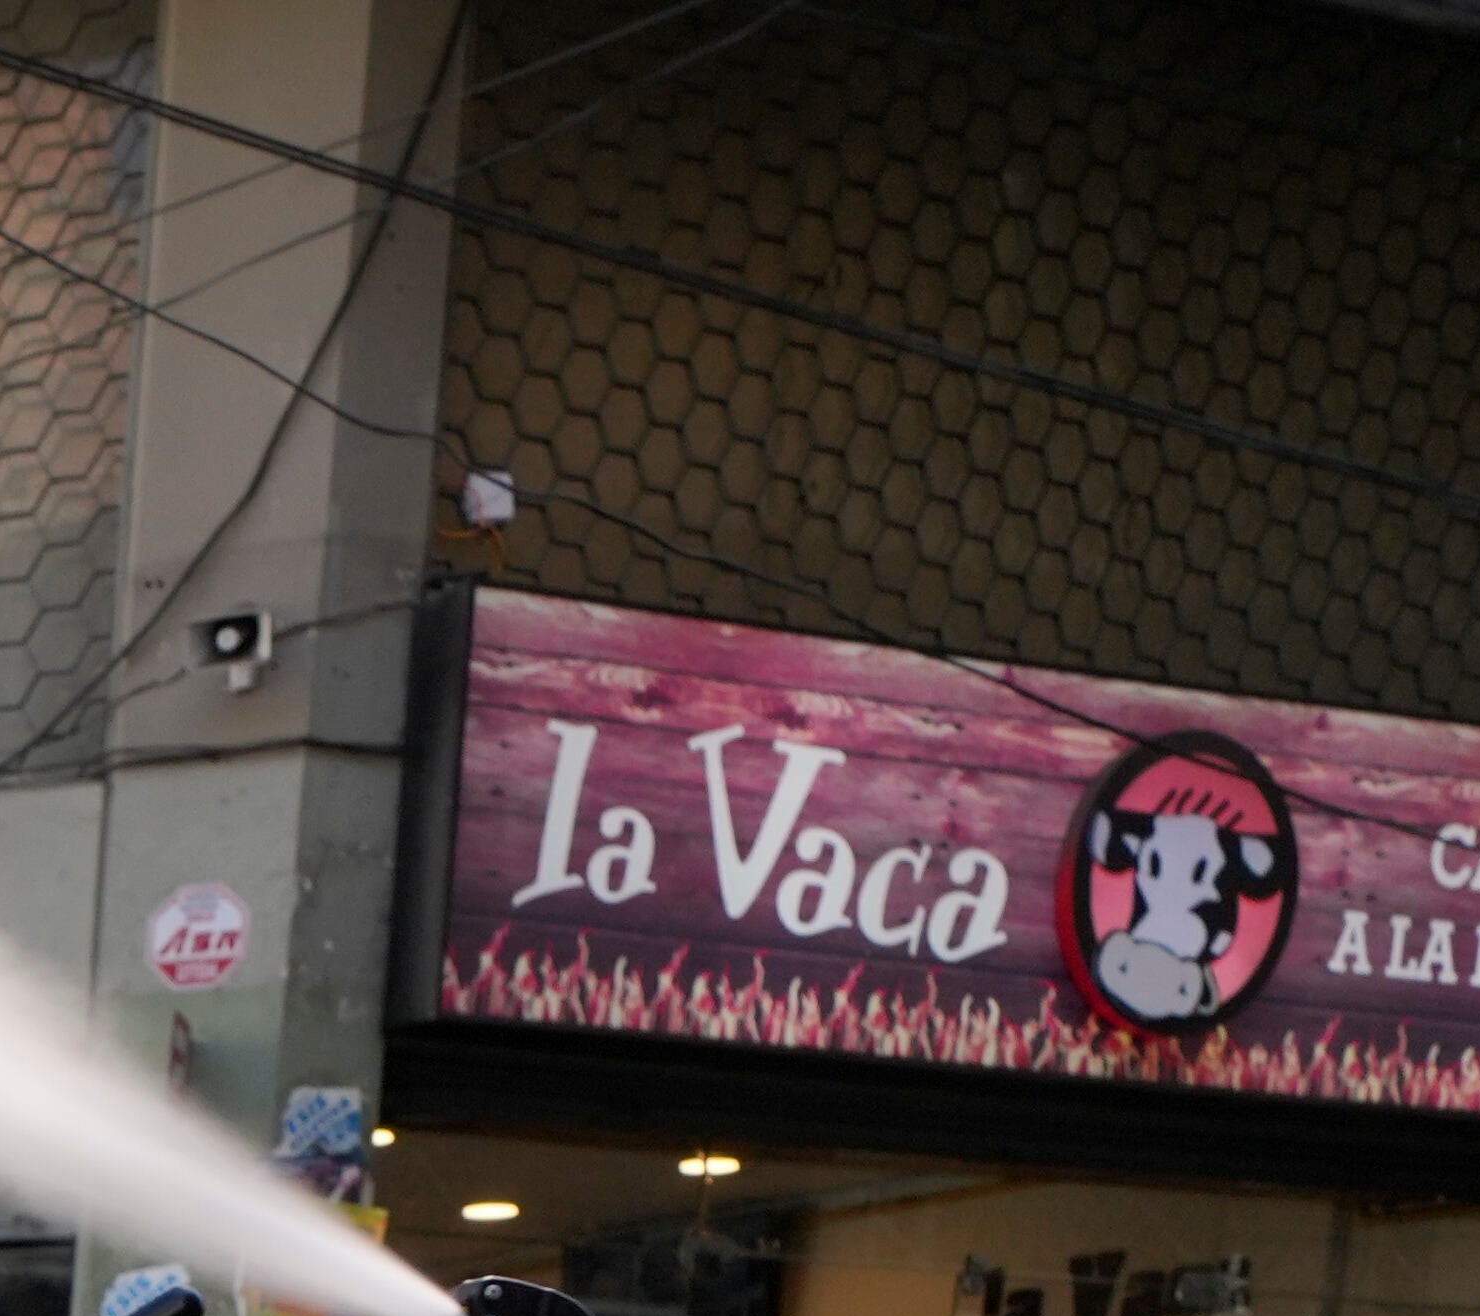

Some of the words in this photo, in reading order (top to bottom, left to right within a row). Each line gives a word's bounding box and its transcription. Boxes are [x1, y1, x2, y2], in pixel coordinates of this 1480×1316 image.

[687, 720, 1009, 964] Vaca
[1326, 908, 1374, 976] A
[1384, 914, 1459, 986] LA
